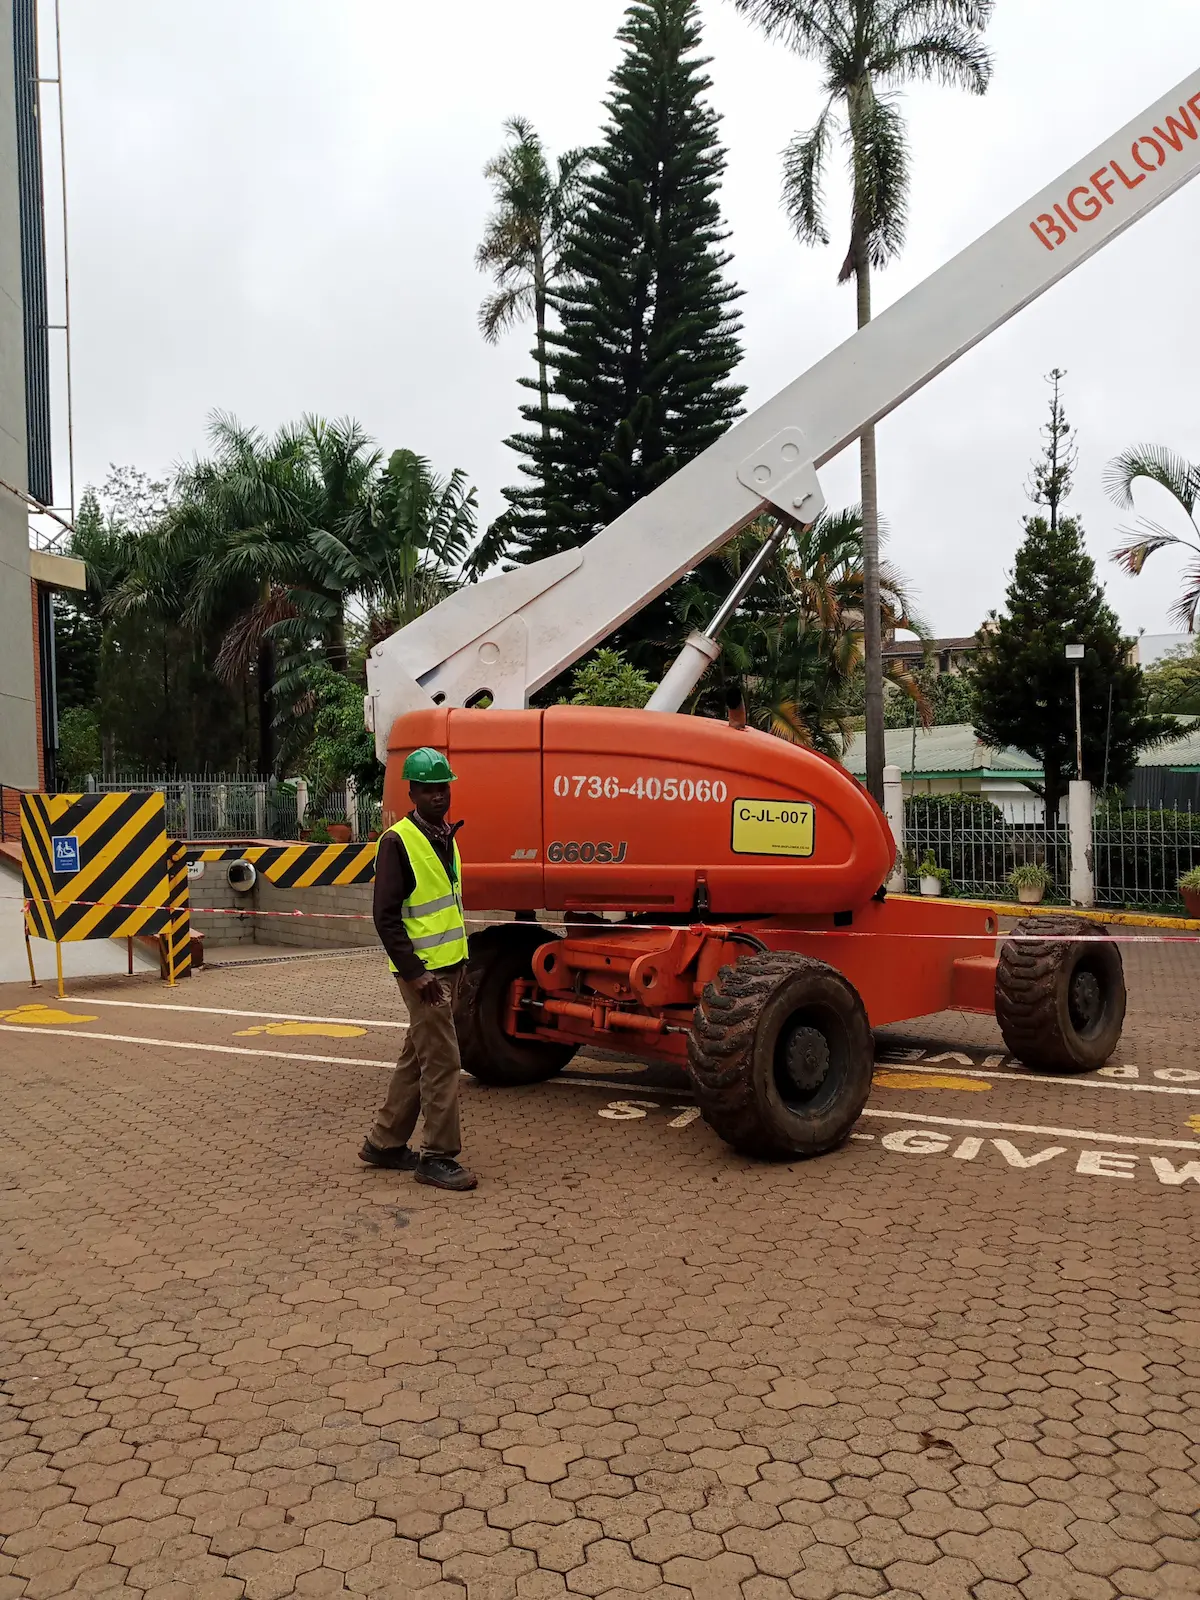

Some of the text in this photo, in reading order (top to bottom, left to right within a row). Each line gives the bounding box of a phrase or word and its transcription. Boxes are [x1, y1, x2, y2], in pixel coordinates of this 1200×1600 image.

[553, 775, 728, 803] 0736-405060
[739, 808, 809, 825] C-JL-007
[547, 840, 628, 864] 660SJ
